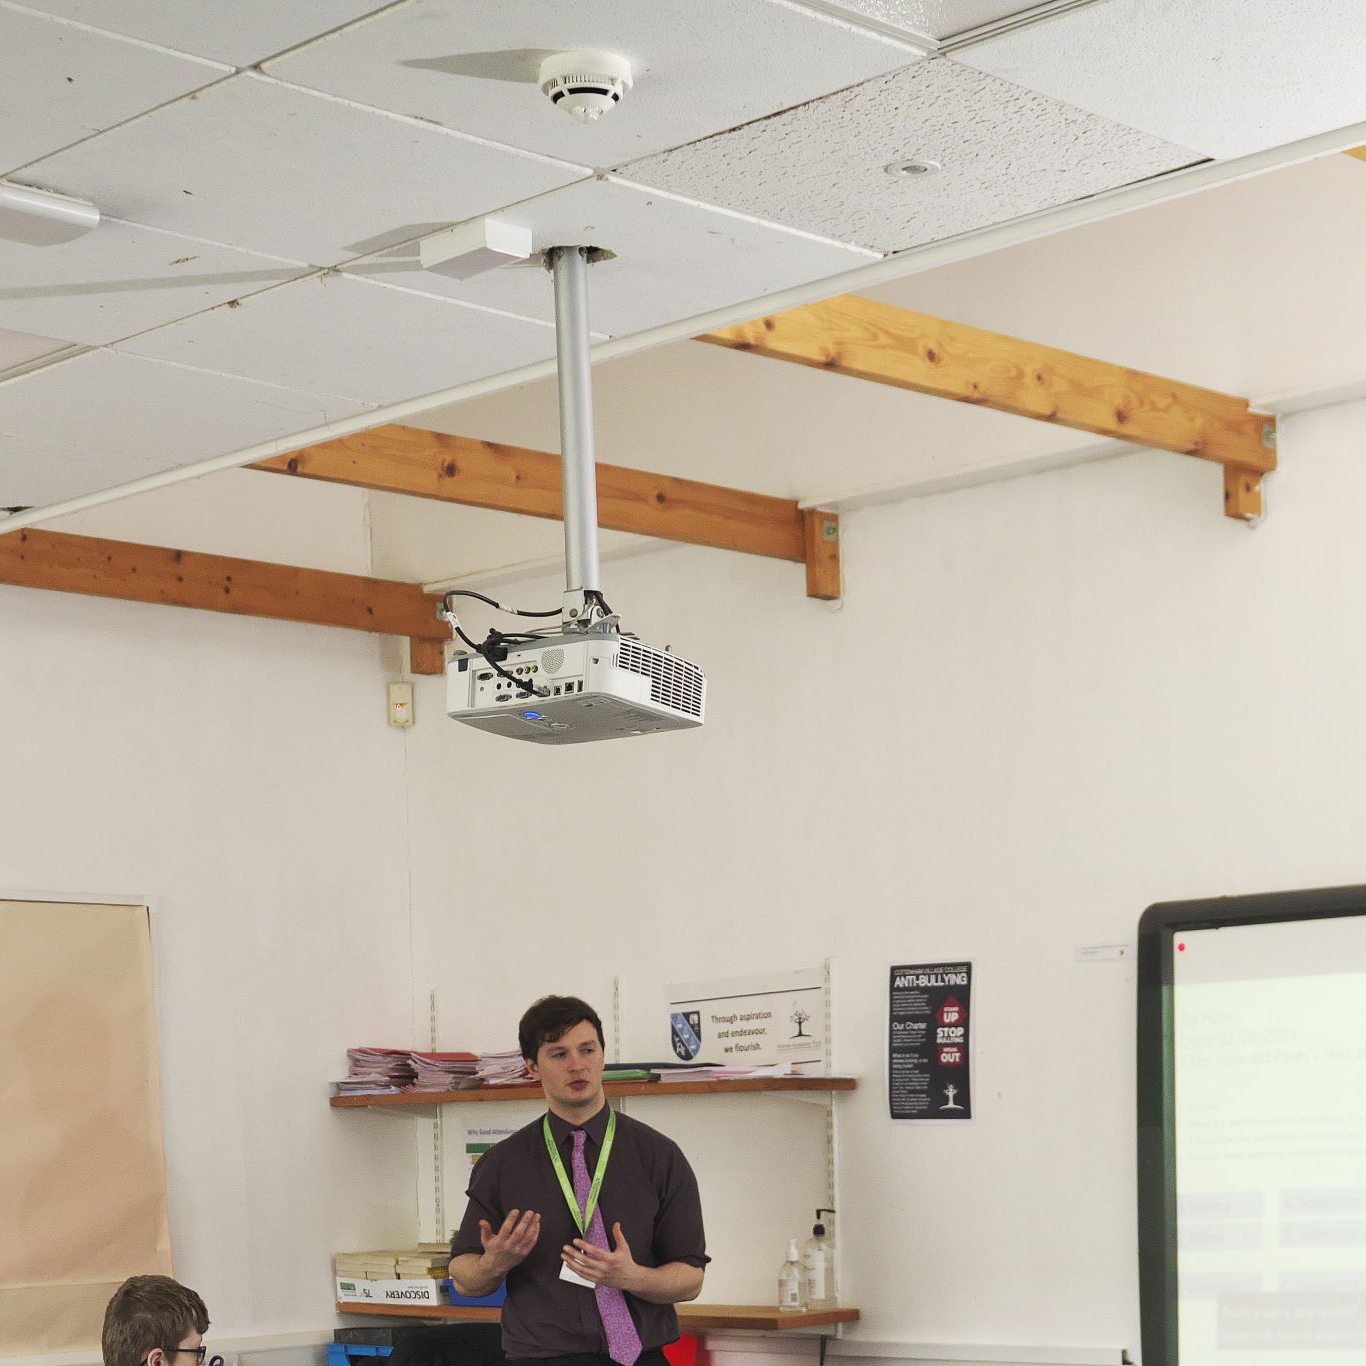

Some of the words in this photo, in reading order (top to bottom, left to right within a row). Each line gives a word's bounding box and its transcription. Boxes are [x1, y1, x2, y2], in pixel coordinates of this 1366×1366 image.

[894, 973, 968, 988] ANTI-BULLYING
[710, 1013, 738, 1025] Through
[739, 1010, 772, 1022] aspiration
[943, 1012, 959, 1023] UP
[717, 1030, 729, 1039] and
[936, 1026, 965, 1037] STOP
[940, 1052, 961, 1063] OUT
[385, 1290, 430, 1300] DISCOVERY
